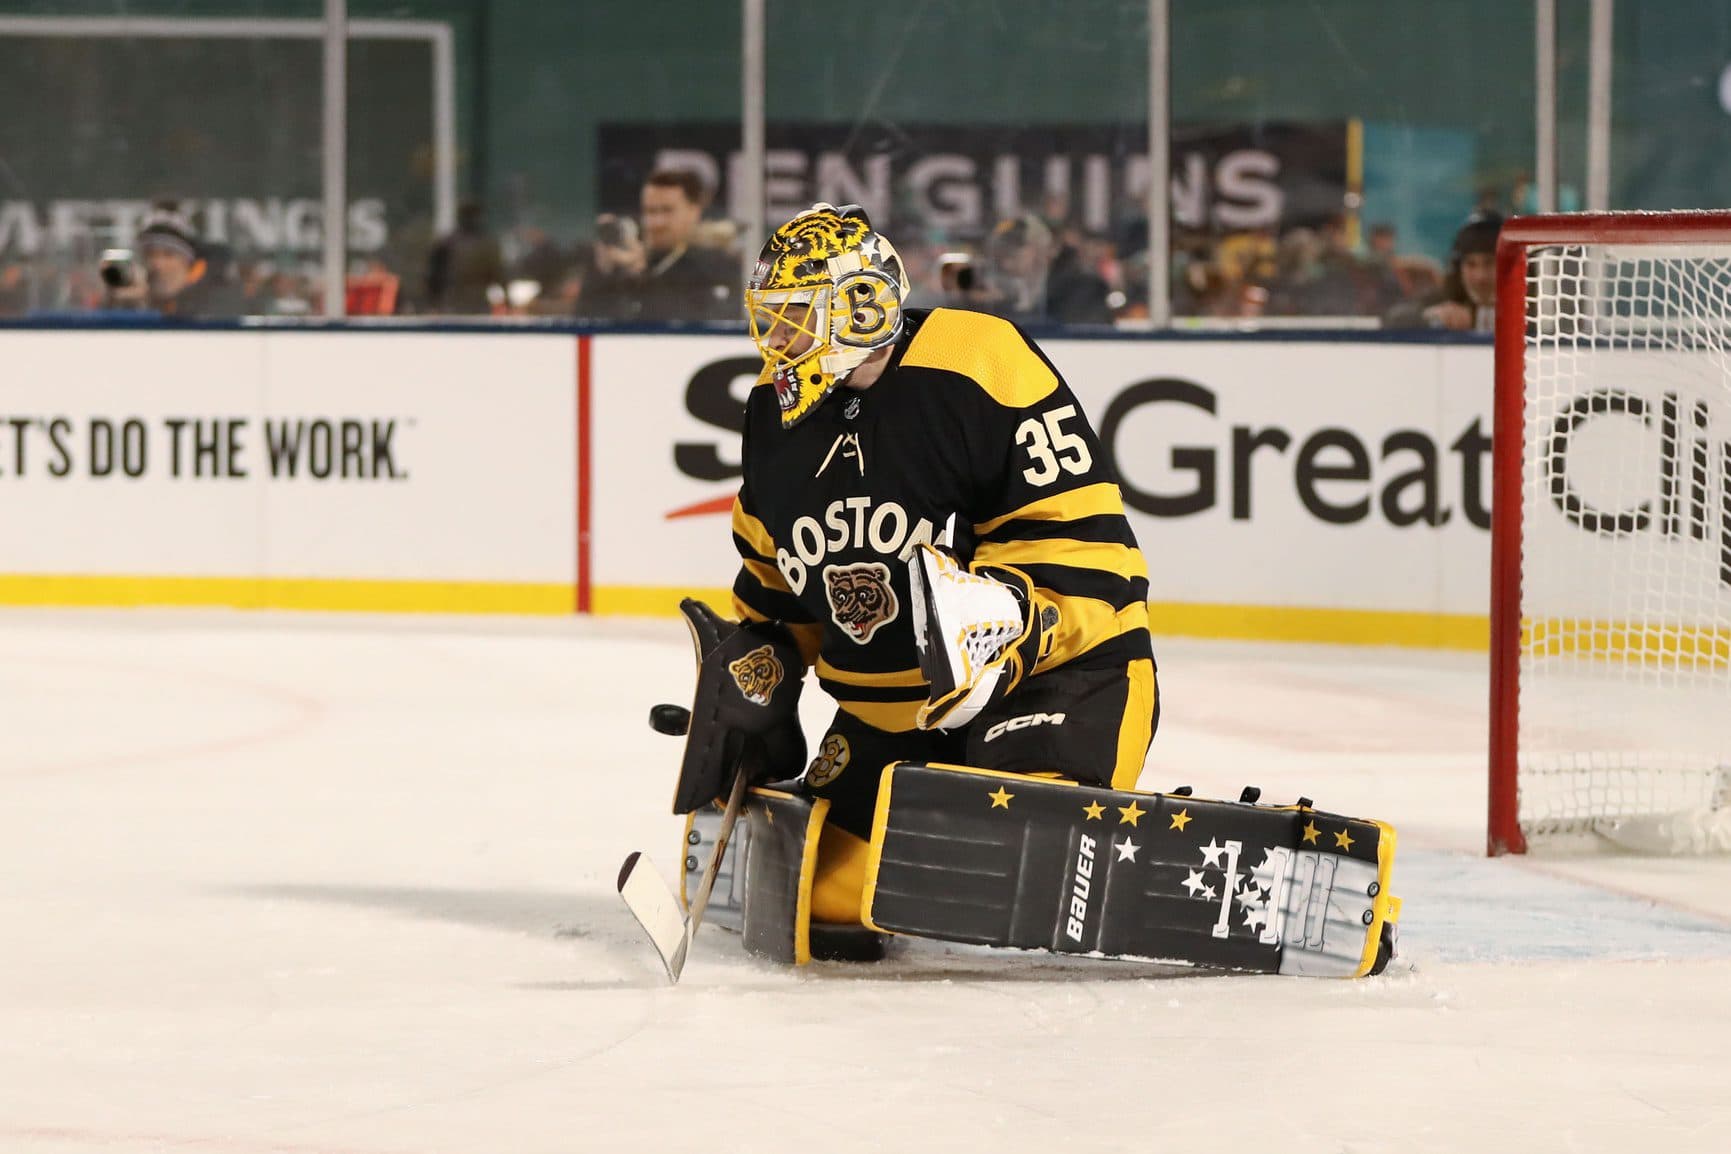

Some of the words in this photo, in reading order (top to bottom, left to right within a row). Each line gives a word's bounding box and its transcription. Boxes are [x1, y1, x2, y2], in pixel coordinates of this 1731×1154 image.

[0, 418, 73, 478] T'S
[89, 418, 147, 479] DO
[164, 418, 249, 480] THE
[265, 418, 410, 480] WORK.
[1015, 404, 1093, 488] 35
[1097, 377, 1493, 531] Great
[983, 712, 1066, 743] CCM
